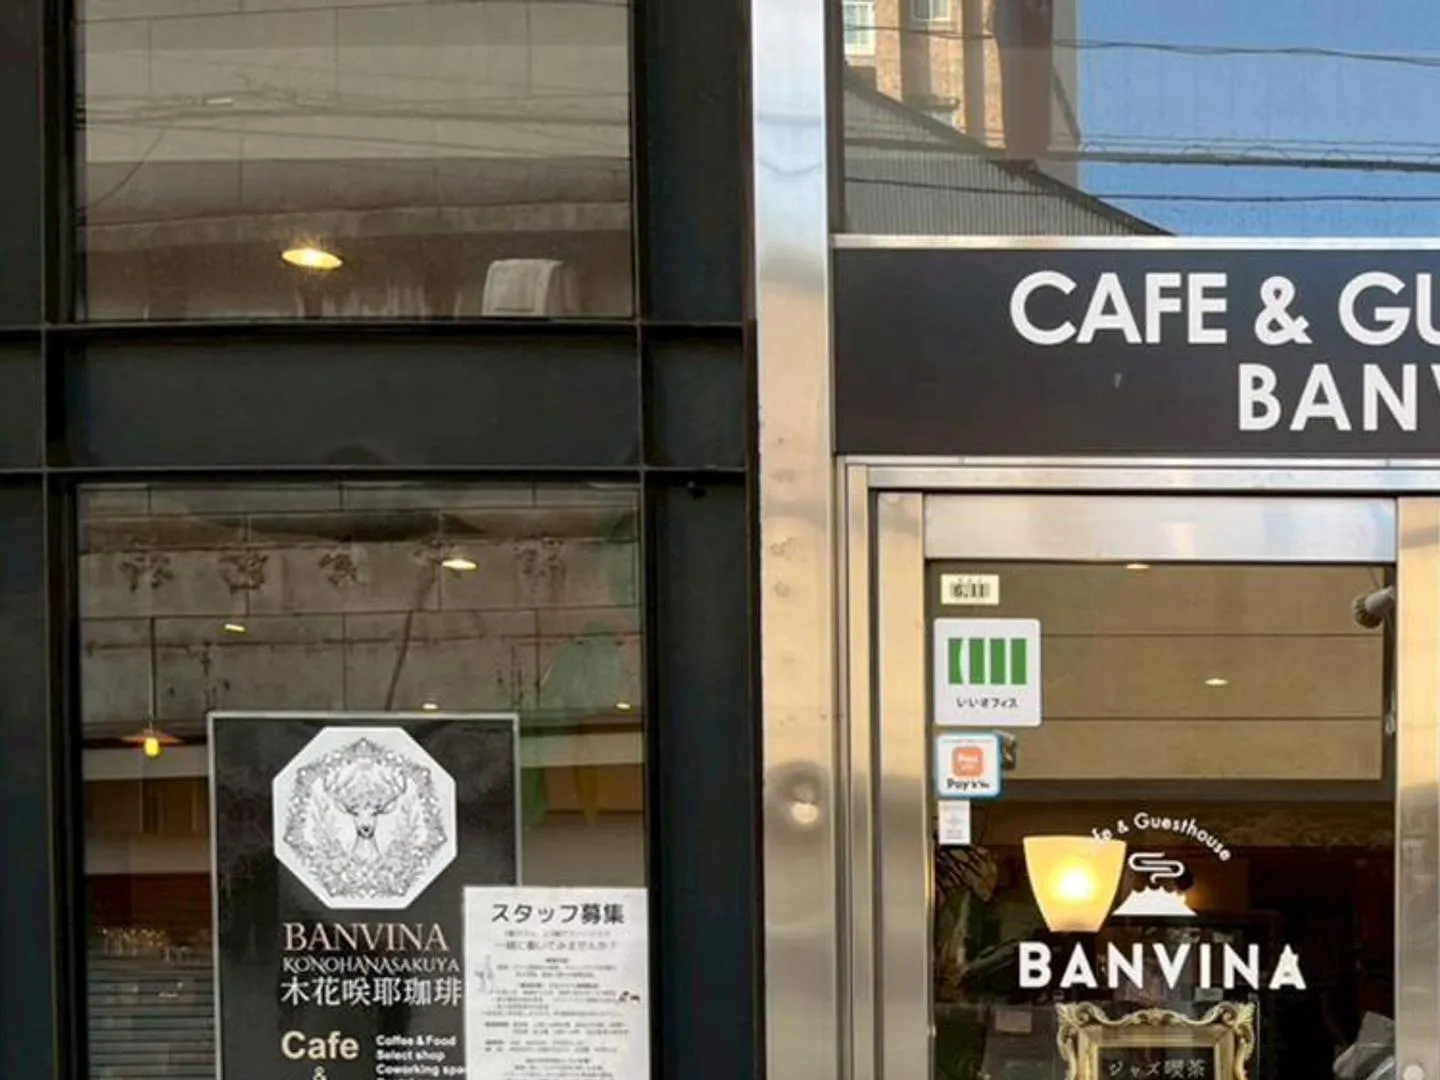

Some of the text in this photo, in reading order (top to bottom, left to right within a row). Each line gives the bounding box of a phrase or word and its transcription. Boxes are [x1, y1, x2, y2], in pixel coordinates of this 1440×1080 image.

[1009, 271, 1227, 346] CAFE
[1254, 276, 1313, 346] &
[1117, 819, 1130, 834] &
[1134, 811, 1231, 861] Guesthouse
[492, 903, 624, 924] スタッフ募集
[283, 922, 450, 951] BANVINA
[283, 955, 460, 974] KONOHANASAKUYA
[1018, 941, 1307, 990] BANVINA
[280, 975, 463, 1006] 木花咲耶珈琲
[281, 1030, 360, 1060] Cafe
[375, 1050, 445, 1062] Select shop
[375, 1064, 440, 1077] Coworking
